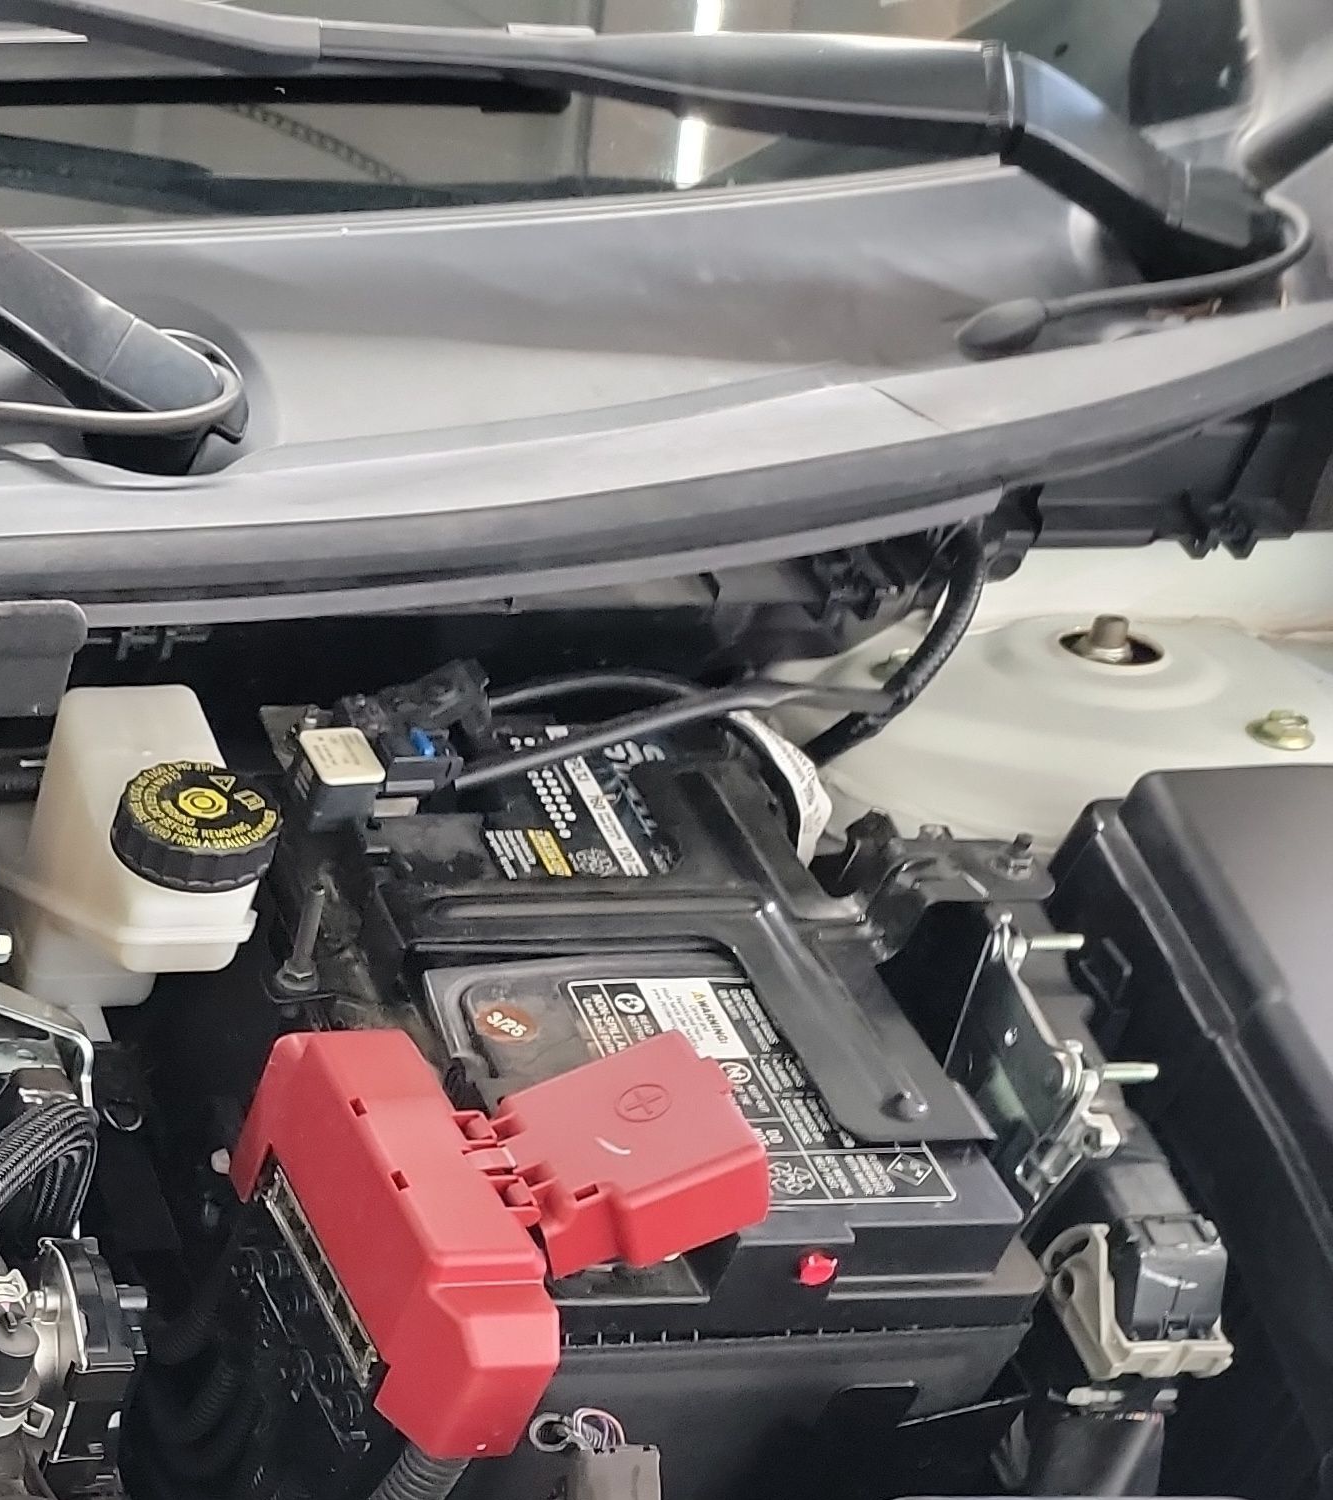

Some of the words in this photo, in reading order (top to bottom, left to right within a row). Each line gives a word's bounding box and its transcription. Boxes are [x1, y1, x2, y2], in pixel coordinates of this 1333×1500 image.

[200, 820, 255, 838] REMOVING
[167, 832, 201, 848] FROM
[201, 838, 211, 848] A
[211, 833, 255, 849] SEALED
[589, 993, 631, 1050] NON-SPILLA
